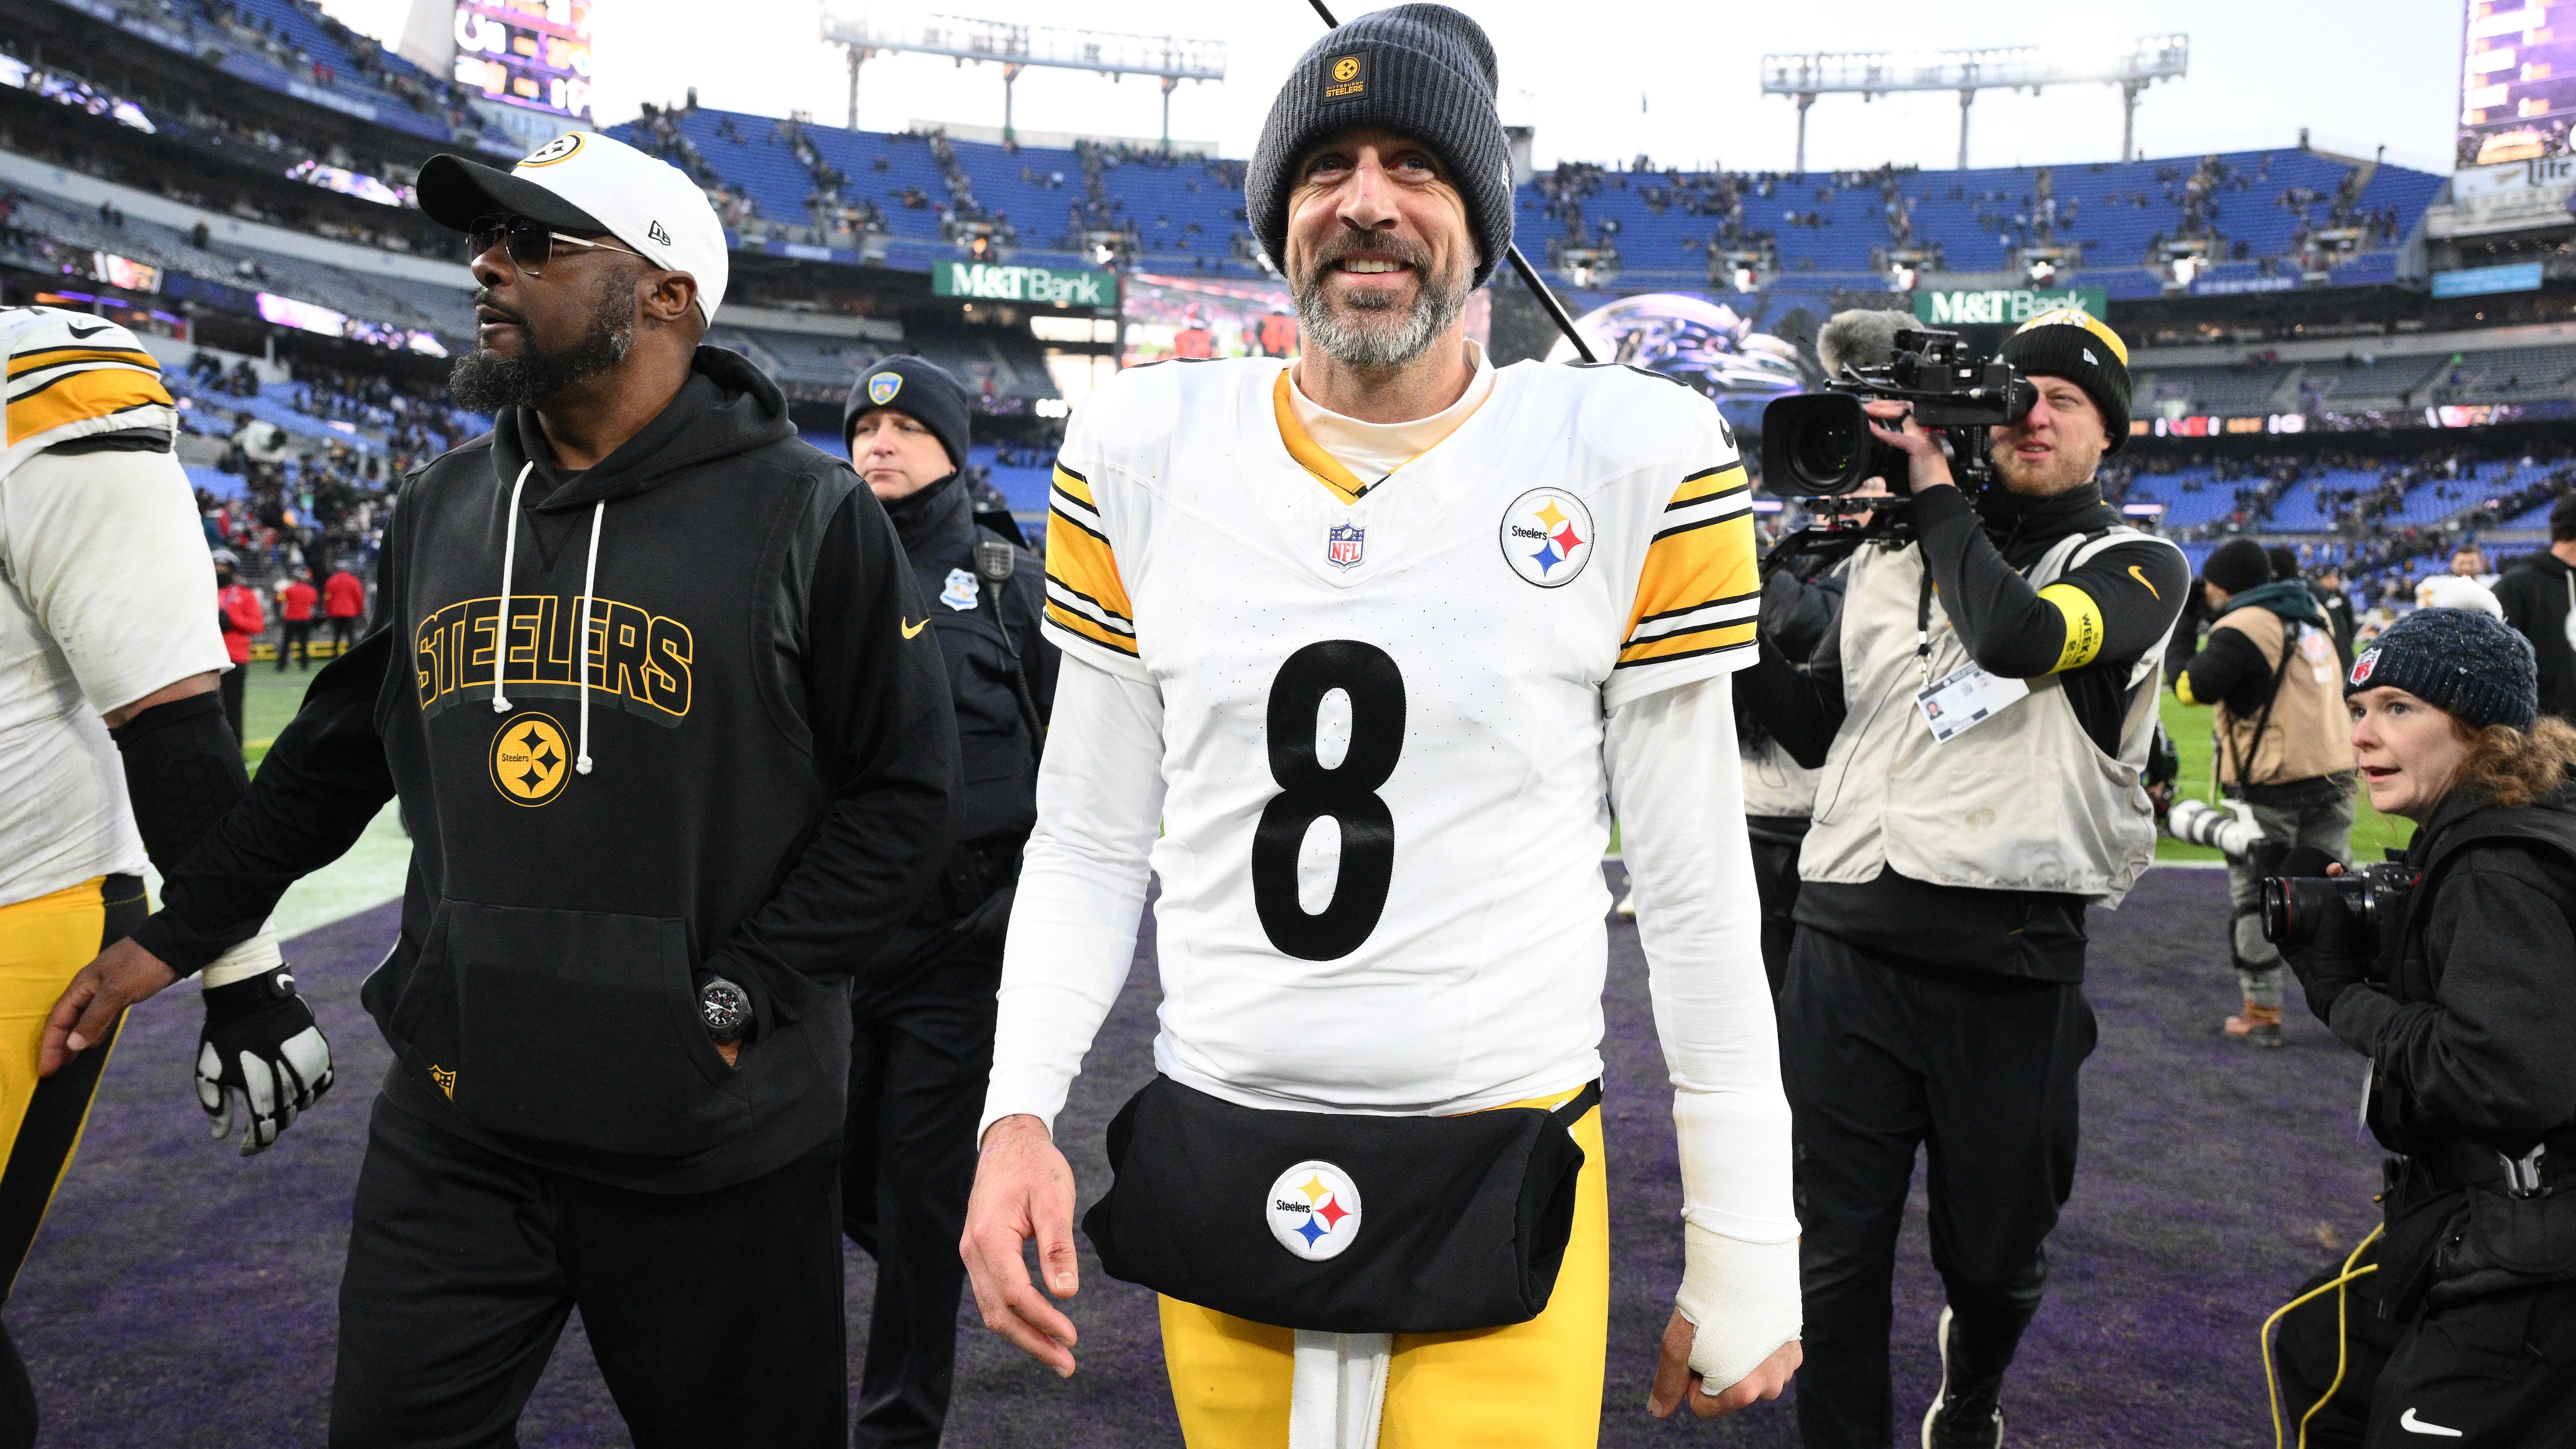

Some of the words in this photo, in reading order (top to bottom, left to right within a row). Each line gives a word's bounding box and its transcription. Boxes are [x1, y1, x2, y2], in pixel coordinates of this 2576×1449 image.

[1326, 84, 1363, 97] STEELERS
[1327, 81, 1363, 90] PITTSBURGH
[951, 262, 1028, 300] M&T
[1028, 267, 1100, 304] Bank
[1930, 291, 2011, 324] M&T
[1511, 525, 1548, 541] Steelers
[1331, 542, 1359, 562] NFL
[415, 595, 693, 717] STEELERS
[501, 753, 529, 762] Steelers
[1252, 639, 1407, 962] 8
[1276, 1199, 1310, 1213] Steelers
